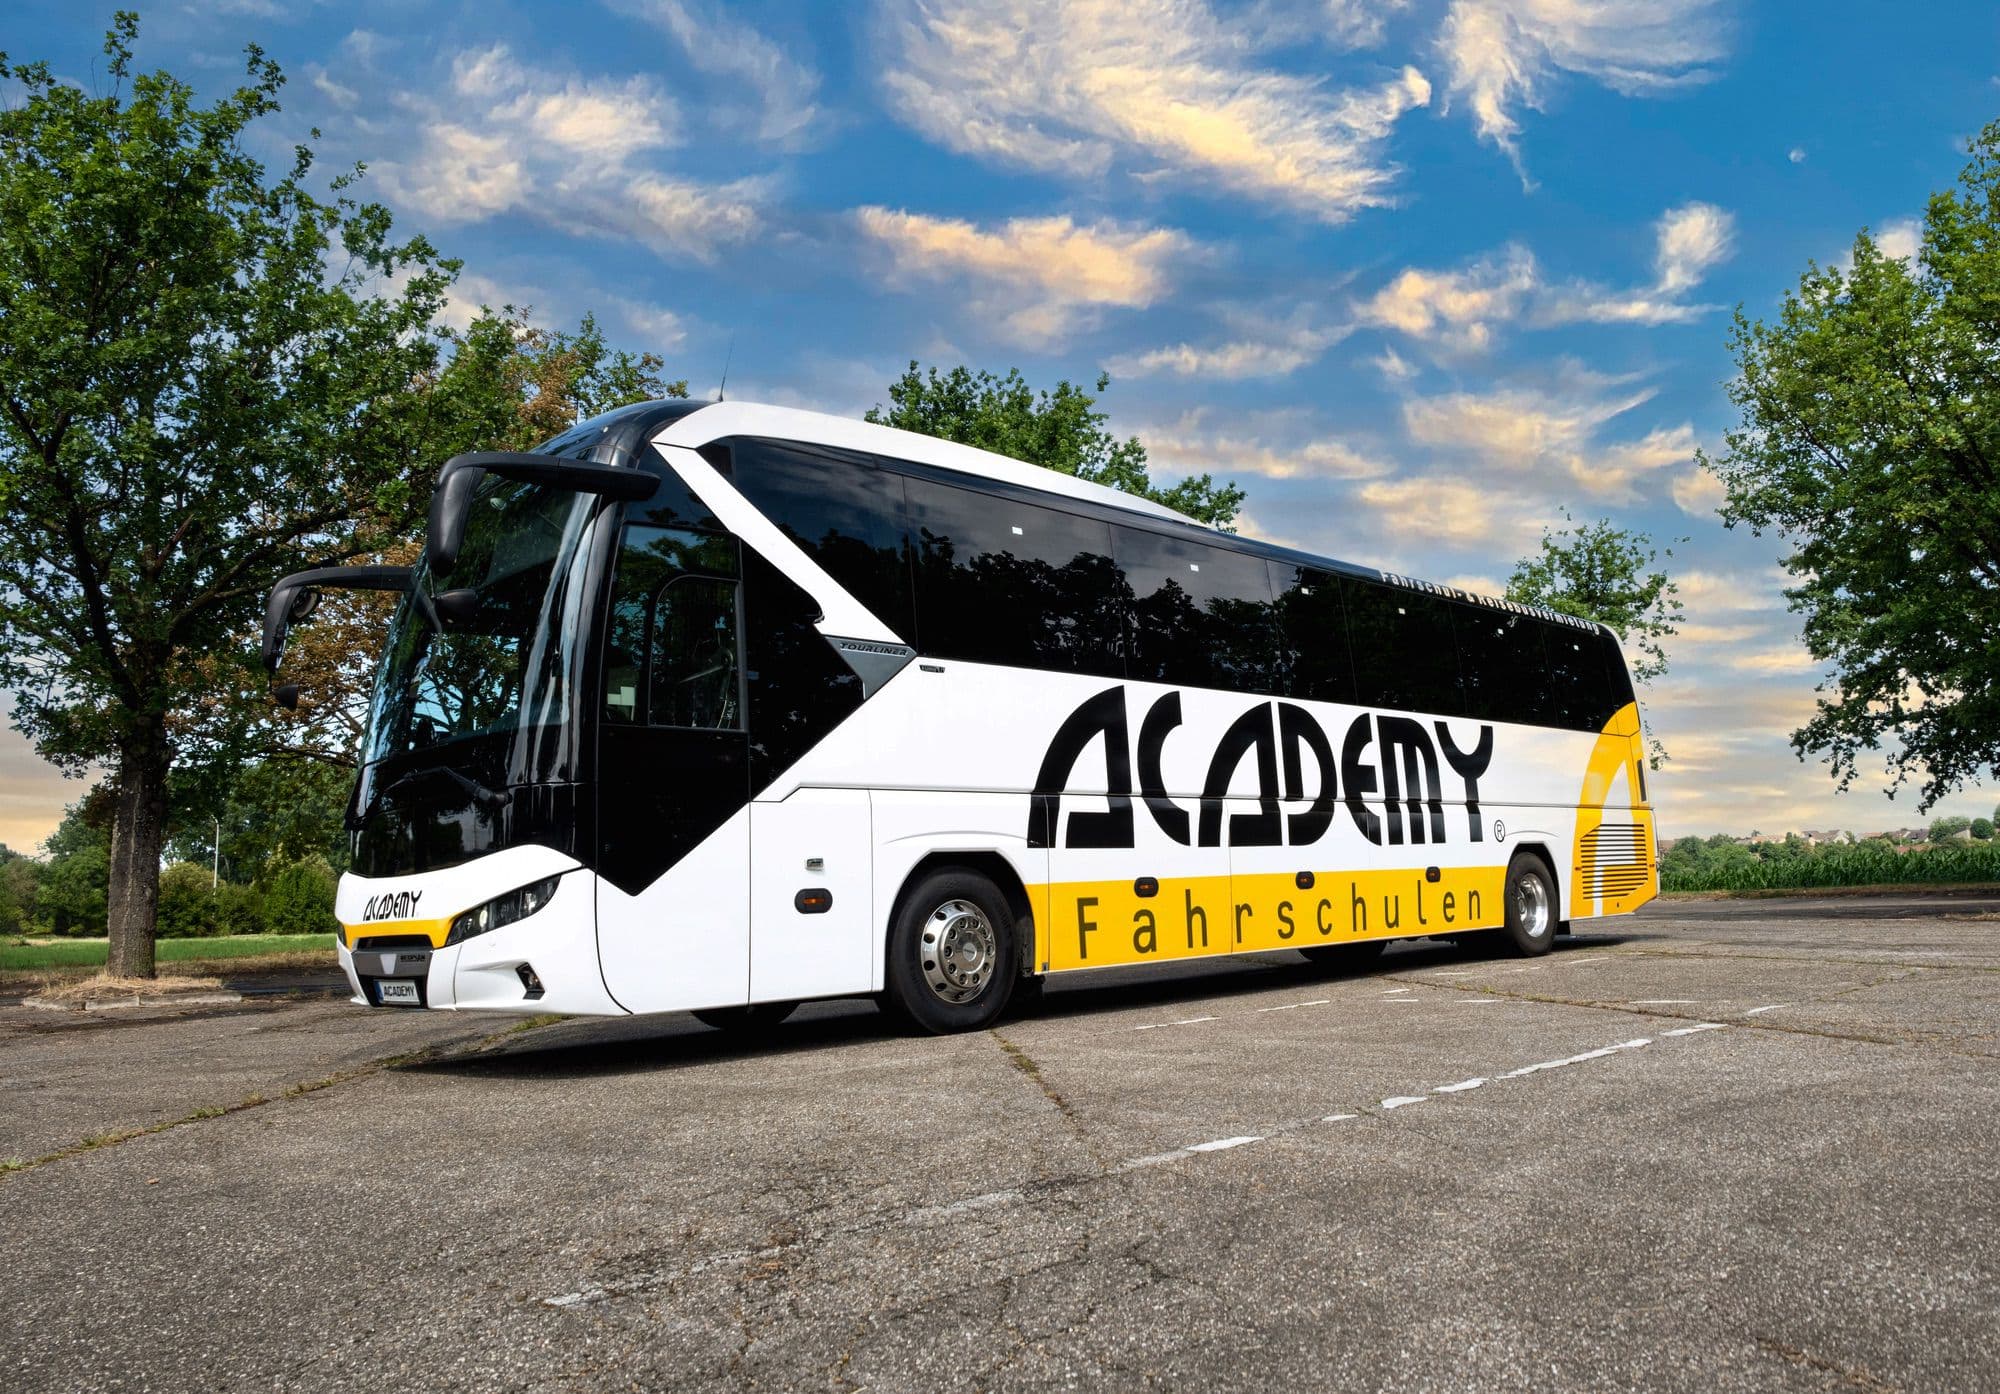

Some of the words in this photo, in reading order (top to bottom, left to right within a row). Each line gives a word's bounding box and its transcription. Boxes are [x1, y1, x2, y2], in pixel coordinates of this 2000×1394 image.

[840, 642, 908, 656] TOURLINER
[1027, 685, 1494, 849] ACADEMY
[363, 889, 423, 921] ACADEMY
[1077, 880, 1481, 960] Fahrschulen
[384, 985, 415, 997] ACADEMY
